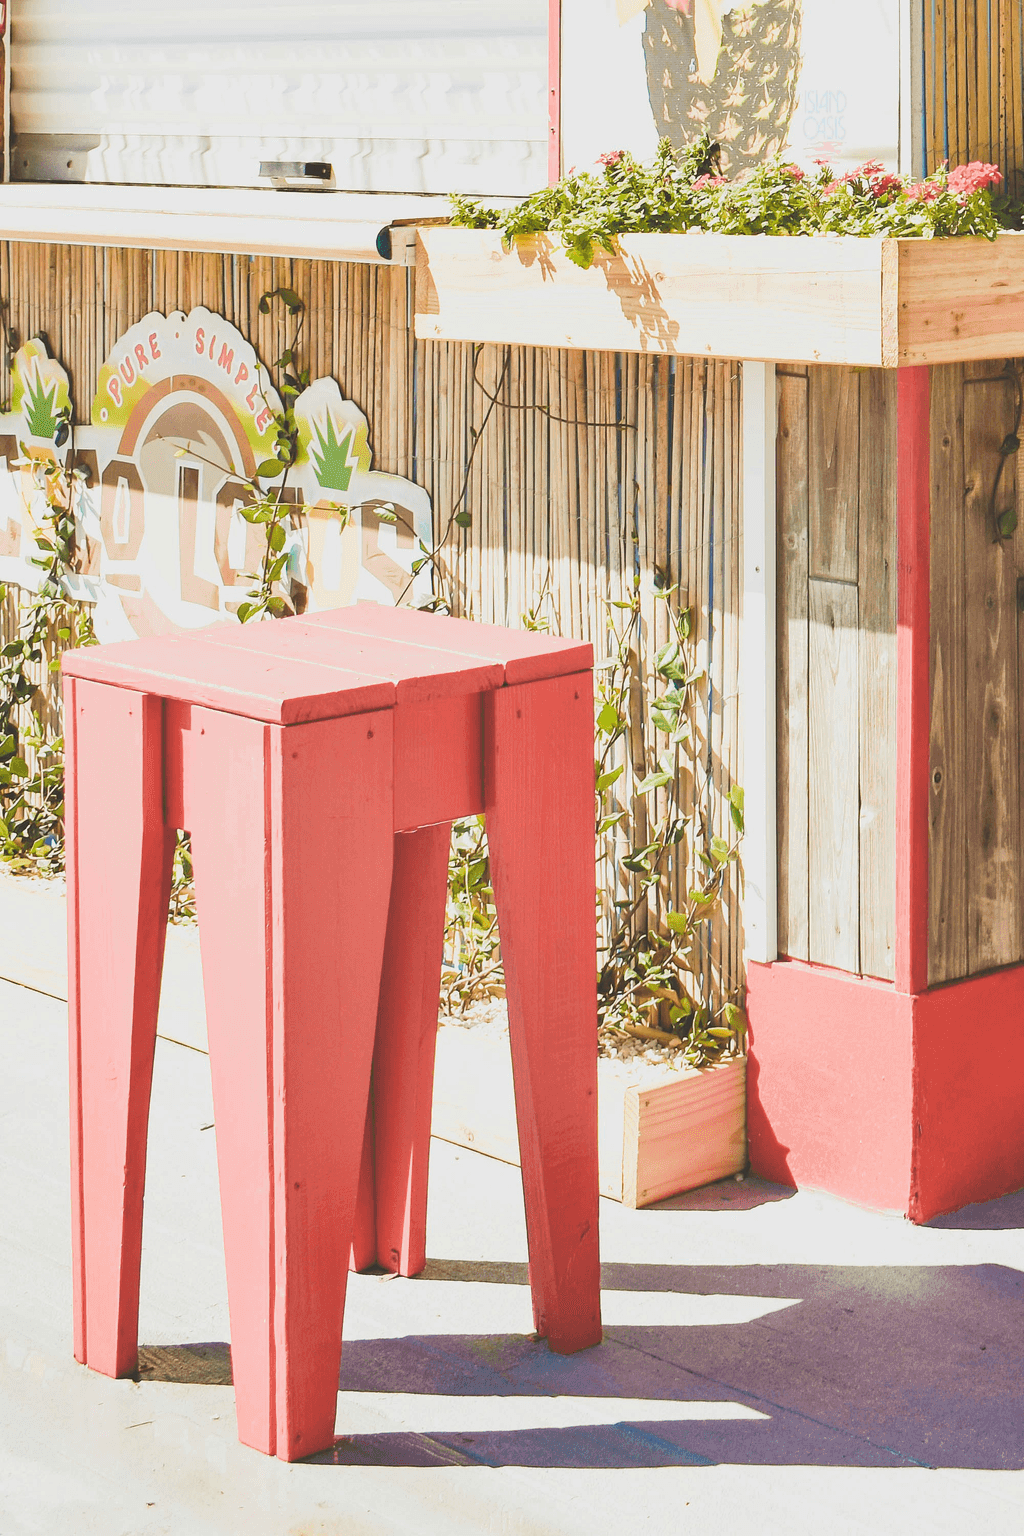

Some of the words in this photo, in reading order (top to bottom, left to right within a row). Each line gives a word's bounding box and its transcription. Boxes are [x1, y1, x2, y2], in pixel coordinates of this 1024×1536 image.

[804, 90, 847, 114] ISLAND
[803, 115, 846, 140] OASIS
[109, 332, 161, 405] PURE
[195, 328, 273, 432] SIMPLE
